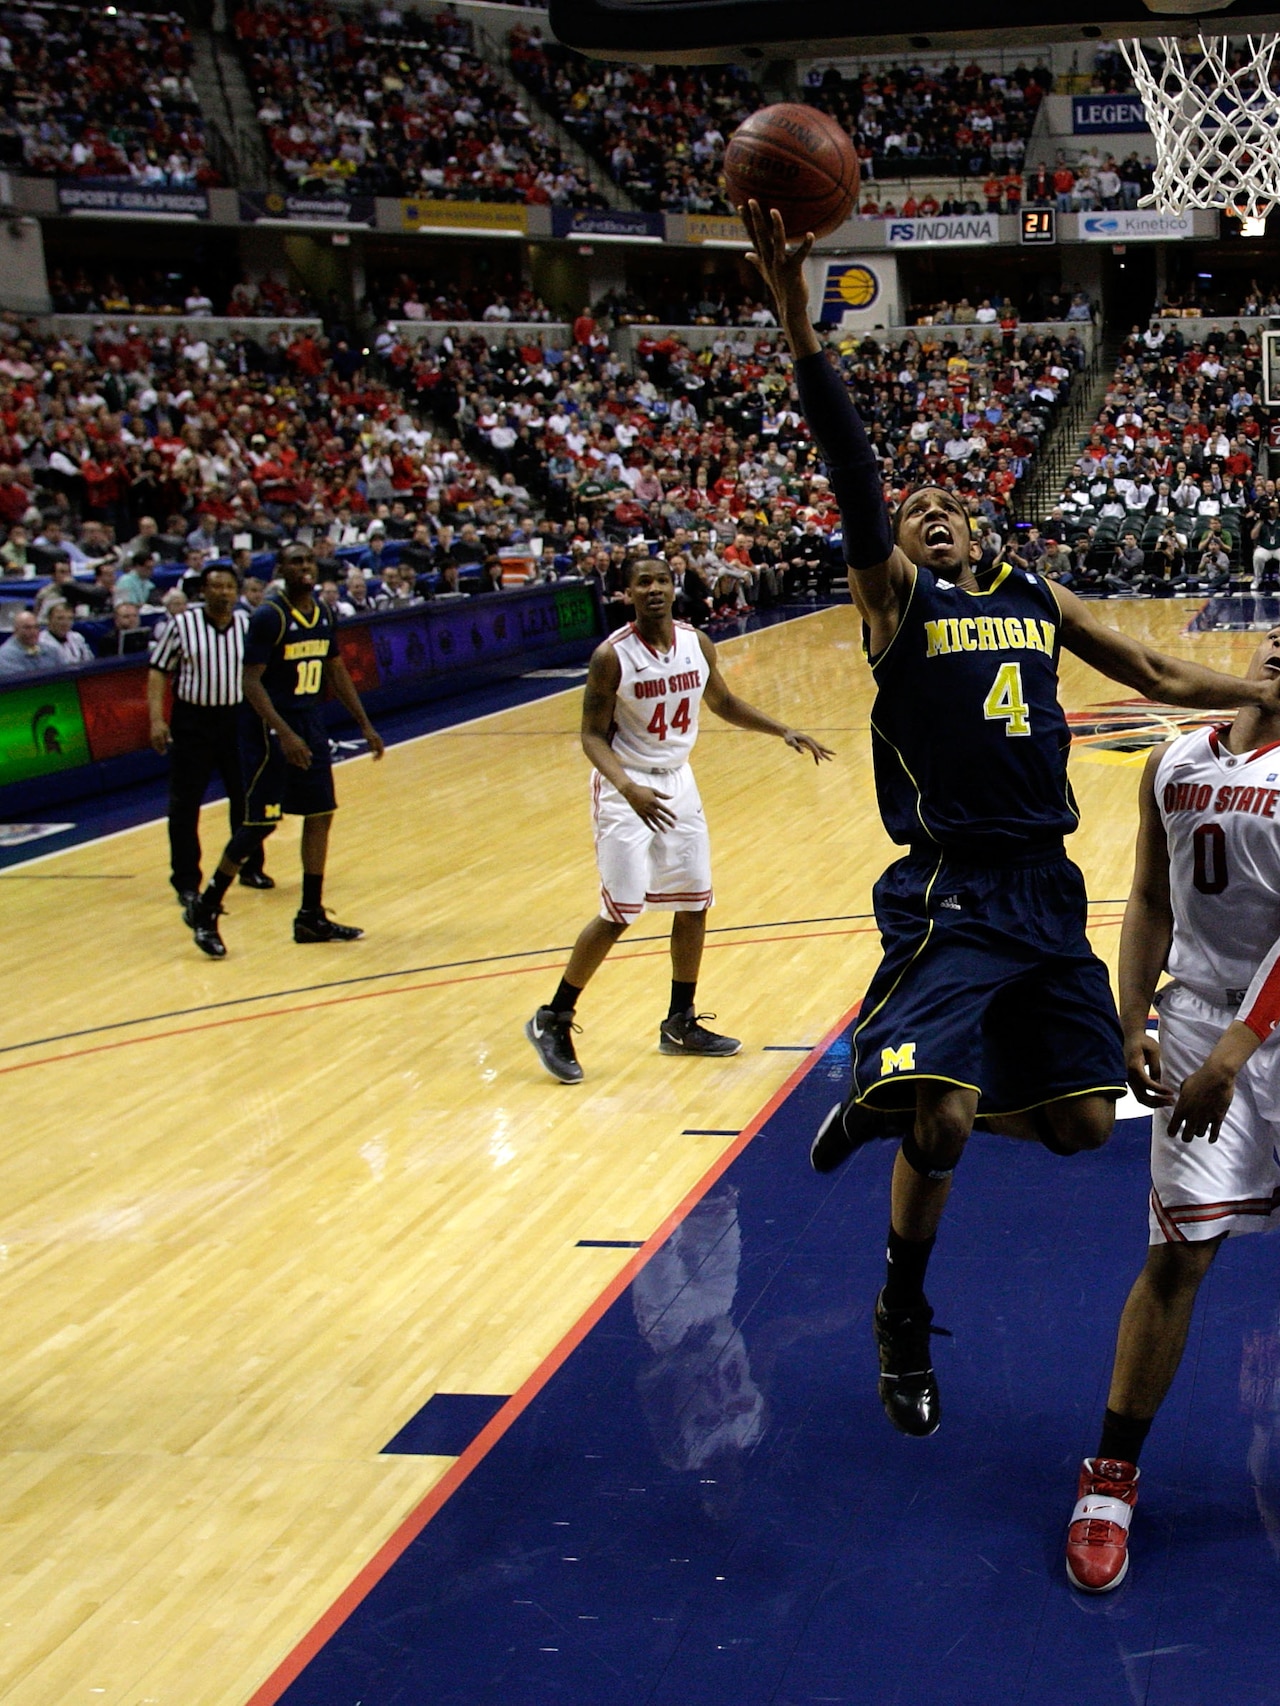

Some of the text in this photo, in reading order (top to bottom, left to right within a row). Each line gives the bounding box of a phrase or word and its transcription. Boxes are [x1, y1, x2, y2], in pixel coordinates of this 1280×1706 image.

[1077, 104, 1145, 125] LEGEN
[889, 220, 993, 241] FS INDIANA
[1025, 213, 1050, 233] 21
[1125, 217, 1188, 231] Kinetico
[924, 616, 1056, 659] MICHIGAN
[294, 659, 323, 696] 10
[634, 669, 702, 700] OHIO STATE
[983, 661, 1032, 738] 4
[646, 696, 692, 742] 44
[264, 803, 281, 819] M
[1163, 782, 1214, 815] OHIO
[1193, 823, 1229, 895] 0
[880, 1042, 917, 1077] M
